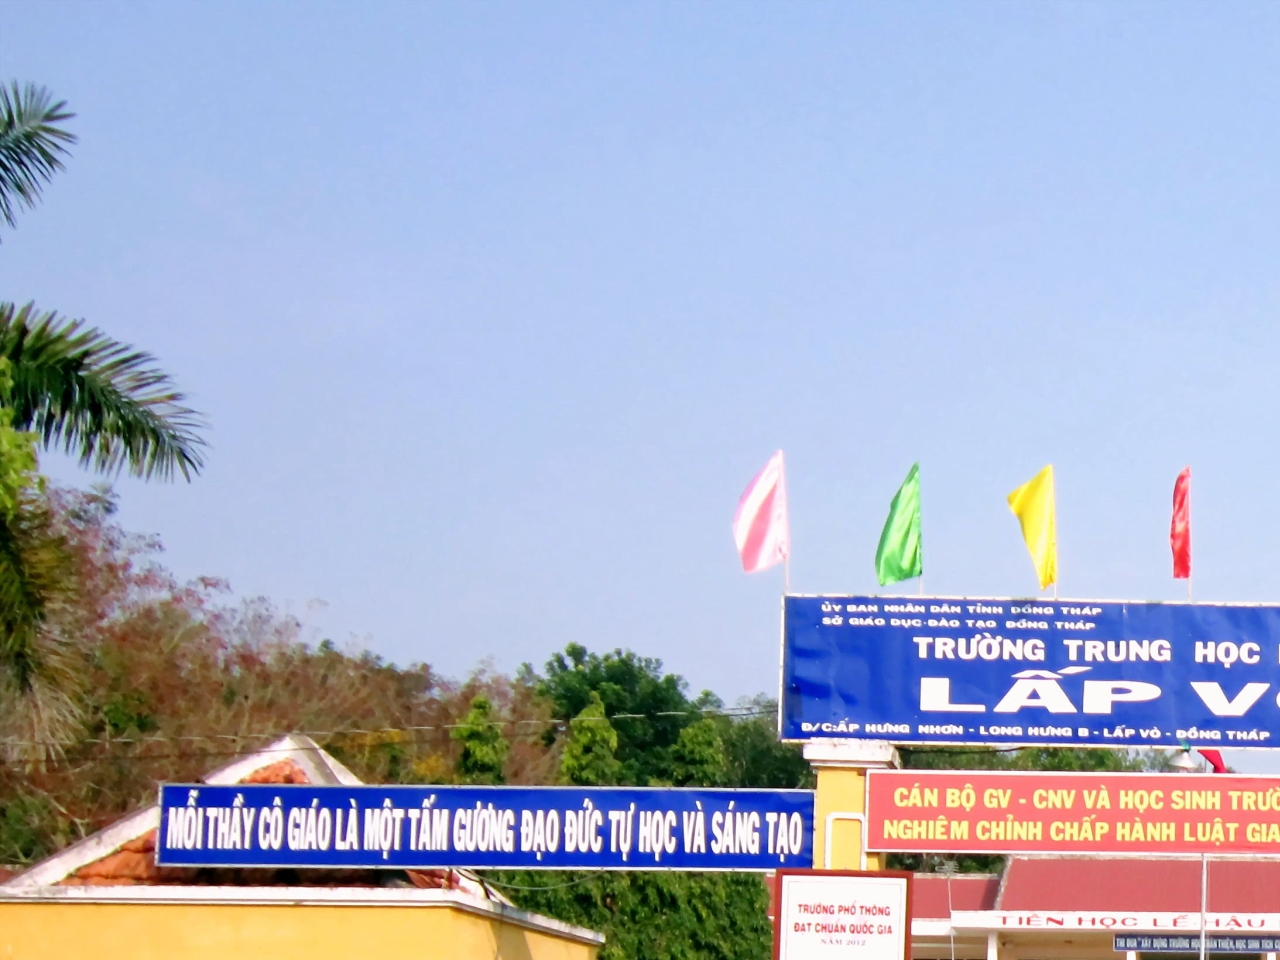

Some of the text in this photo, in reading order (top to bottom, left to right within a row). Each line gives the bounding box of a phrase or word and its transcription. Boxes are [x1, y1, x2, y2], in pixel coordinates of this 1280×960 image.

[821, 601, 842, 612] ỦY
[846, 604, 878, 613] BAN
[884, 603, 925, 613] NHÂN
[930, 603, 961, 613] DÂN
[966, 602, 1003, 614] TỈNH
[1060, 605, 1102, 616] THÁP
[822, 614, 843, 625] SỞ
[848, 616, 886, 626] GIÁO
[965, 619, 997, 629] TẠO
[1054, 619, 1096, 630] THÁP
[912, 632, 1045, 662] TRƯỜNG
[1062, 639, 1171, 662] TRUNG
[1194, 641, 1261, 669] HỌC
[919, 666, 1162, 715] LẤP
[865, 722, 910, 734] HƯNG
[918, 723, 964, 735] NHƠN
[979, 725, 1023, 736] LONG
[1028, 725, 1073, 737] HƯNG
[1078, 727, 1089, 737] B
[1103, 724, 1136, 738] LẤP
[1139, 726, 1162, 738] VÒ
[1226, 728, 1270, 741] THÁP
[893, 783, 938, 808] CÁN
[945, 783, 976, 812] BỘ
[983, 788, 1012, 809] GV
[1033, 789, 1076, 809] CNV
[1083, 785, 1111, 810] VÀ
[1120, 790, 1164, 814] HỌC
[1170, 790, 1221, 811] SINH
[166, 789, 803, 862] MỖI THẦY CÔ GIÁO LÀ MỘT TẤM GƯƠNG ĐẠO ĐỨC TỰ HỌC VÀ SÁNG TẠO
[883, 815, 969, 841] NGHIÊM
[975, 814, 1042, 841] CHỈNH
[1049, 814, 1109, 842] CHẤP
[1116, 817, 1176, 842] HÀNH
[1184, 818, 1239, 846] LUẬT
[859, 904, 890, 916] THÔNG
[794, 922, 812, 935] ĐẠT
[877, 925, 893, 935] GIA
[995, 913, 1064, 926] TIÊN
[1078, 917, 1138, 929] HỌC
[1205, 915, 1265, 930] HẬU
